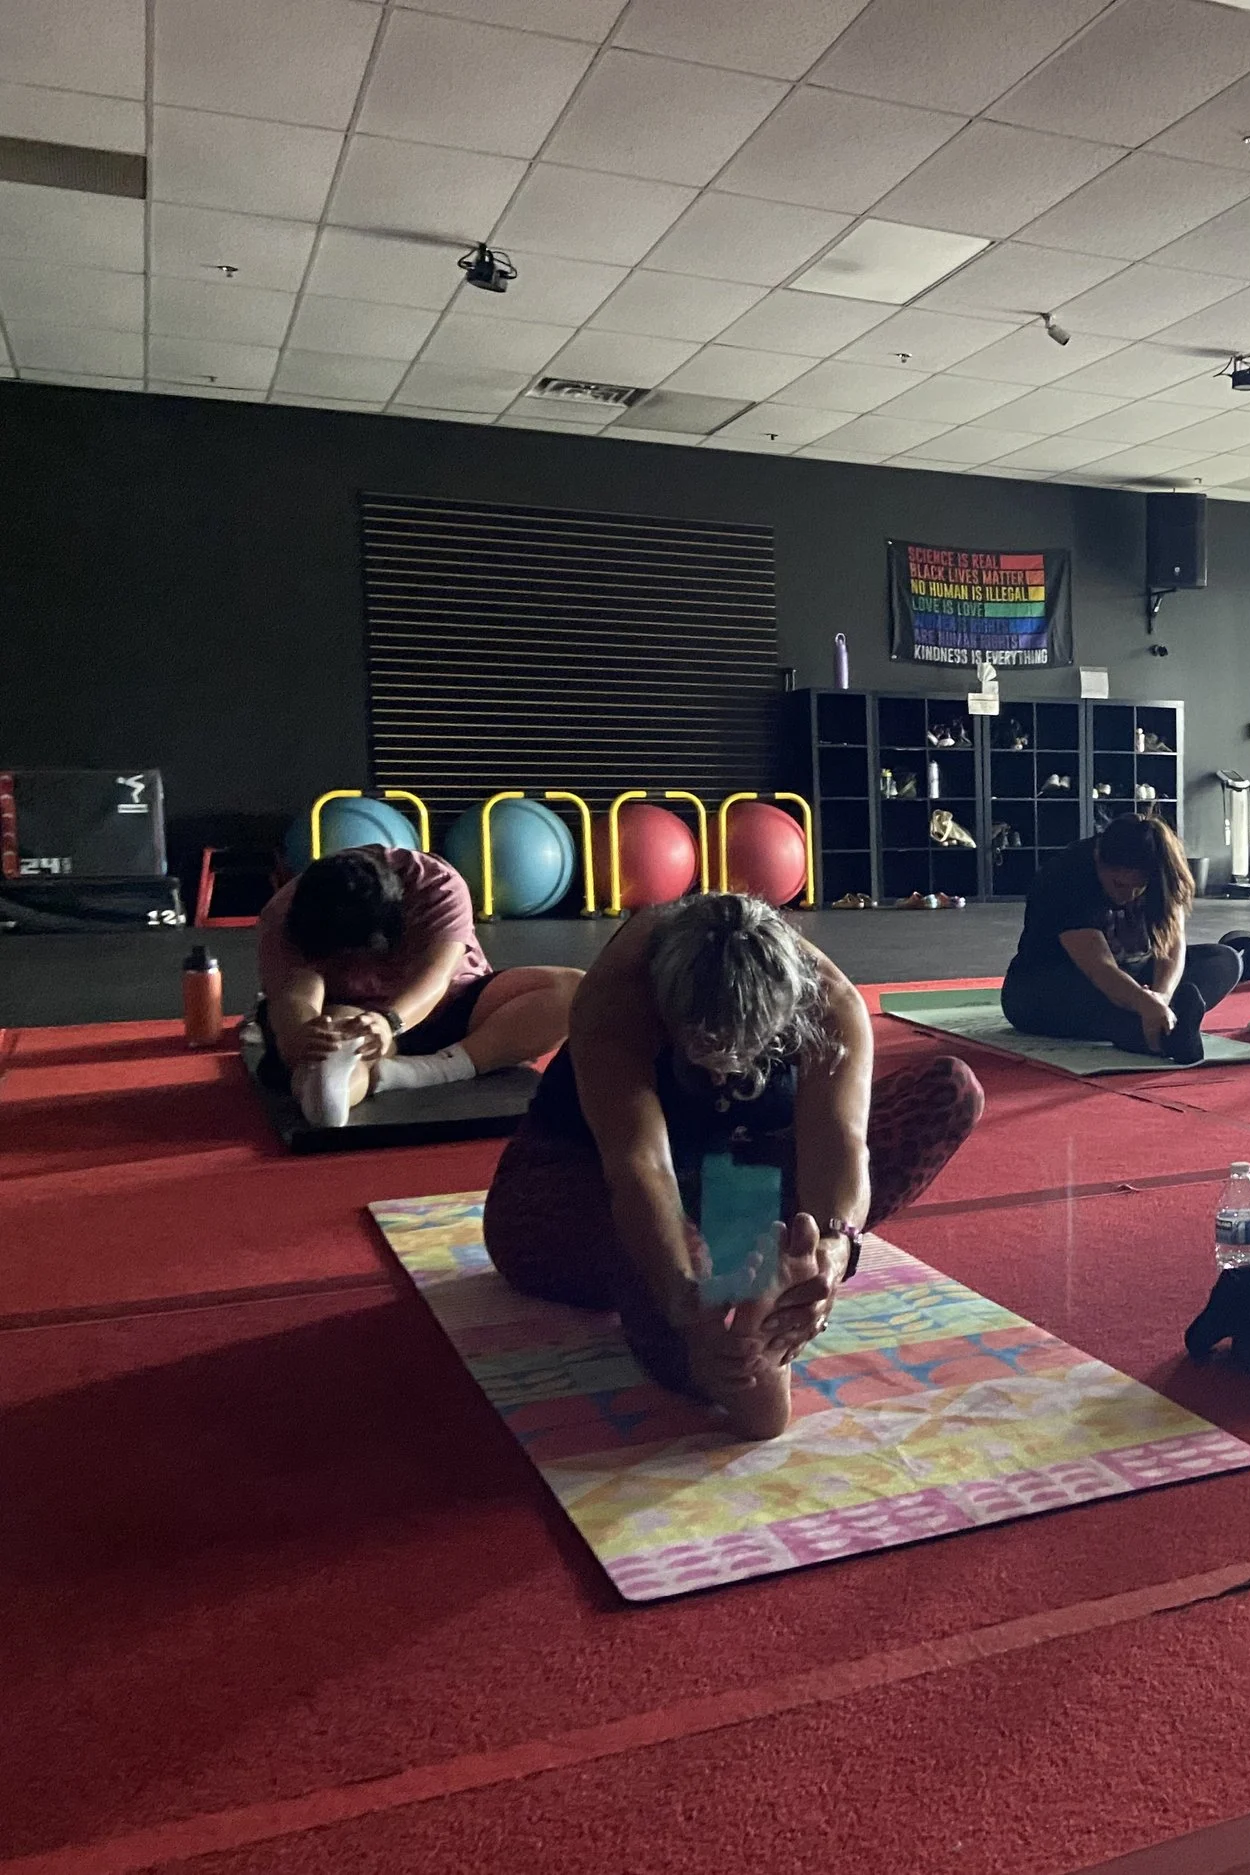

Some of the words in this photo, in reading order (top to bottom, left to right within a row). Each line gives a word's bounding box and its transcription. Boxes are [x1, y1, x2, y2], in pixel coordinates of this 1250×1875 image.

[908, 546, 956, 567] SCIENCE
[957, 553, 969, 568] IS
[971, 554, 999, 569] REAL
[909, 562, 945, 582] BLACK
[950, 567, 979, 584] LIVES
[982, 570, 1027, 585] MATTER
[911, 578, 926, 596] NO
[929, 582, 968, 600] HUMAN
[972, 585, 983, 601] IS
[986, 586, 1029, 602] ILLEGAL
[912, 597, 940, 613] LOVE
[942, 600, 954, 615] IS
[957, 602, 984, 617] LOVE
[914, 644, 967, 665] KINDNESS
[971, 649, 982, 665] IS
[985, 648, 1048, 665] EVERYTHING
